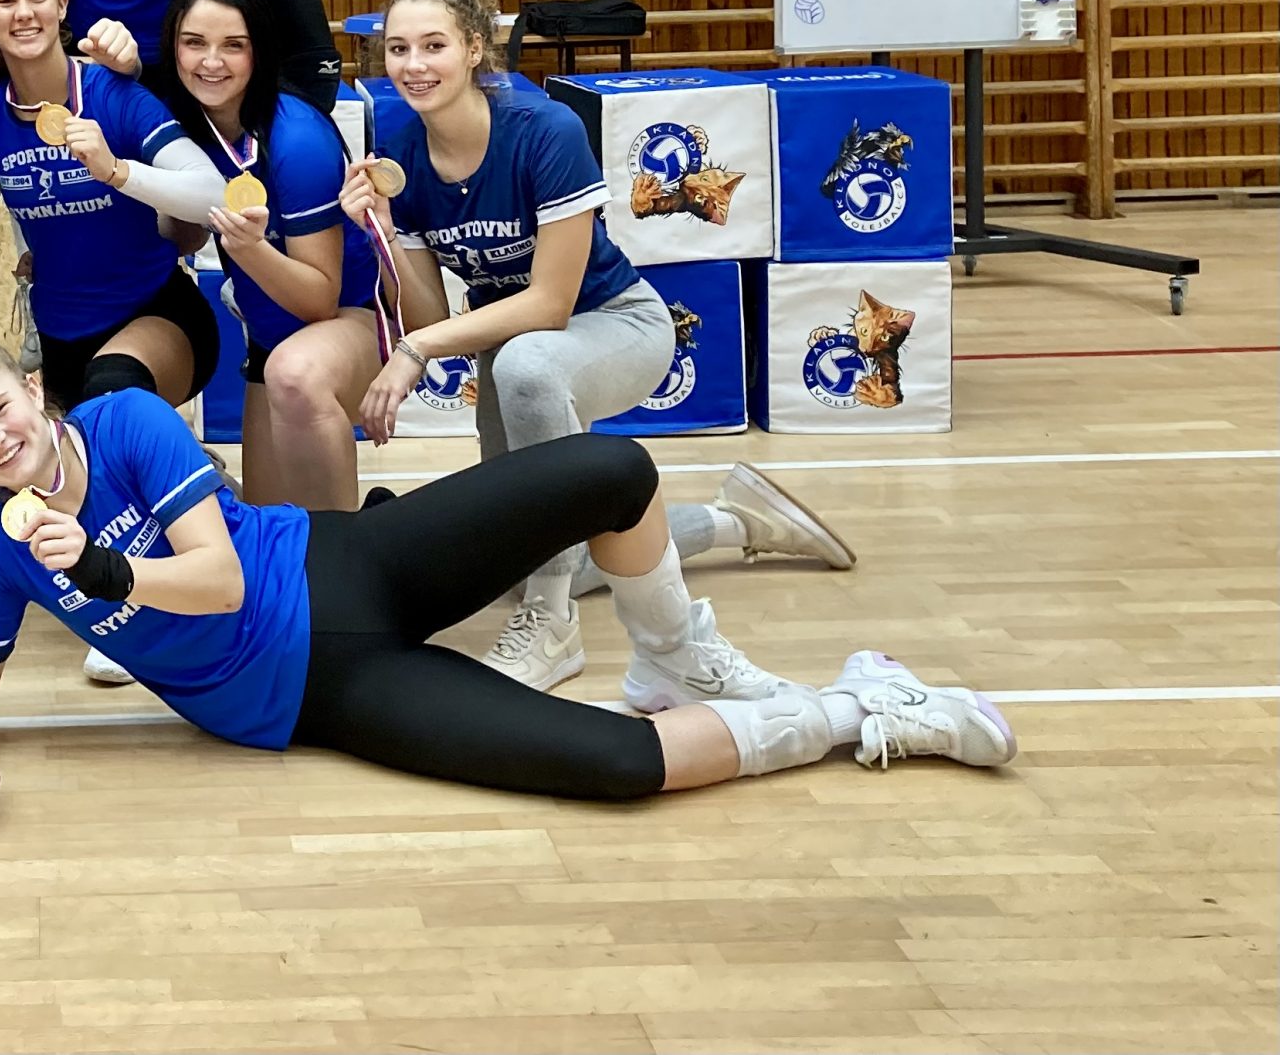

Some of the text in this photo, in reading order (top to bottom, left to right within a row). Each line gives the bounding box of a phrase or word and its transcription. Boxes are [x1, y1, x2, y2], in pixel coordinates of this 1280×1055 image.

[653, 125, 700, 167] KLADN
[62, 168, 91, 180] KLAD
[806, 337, 852, 382] KLADN
